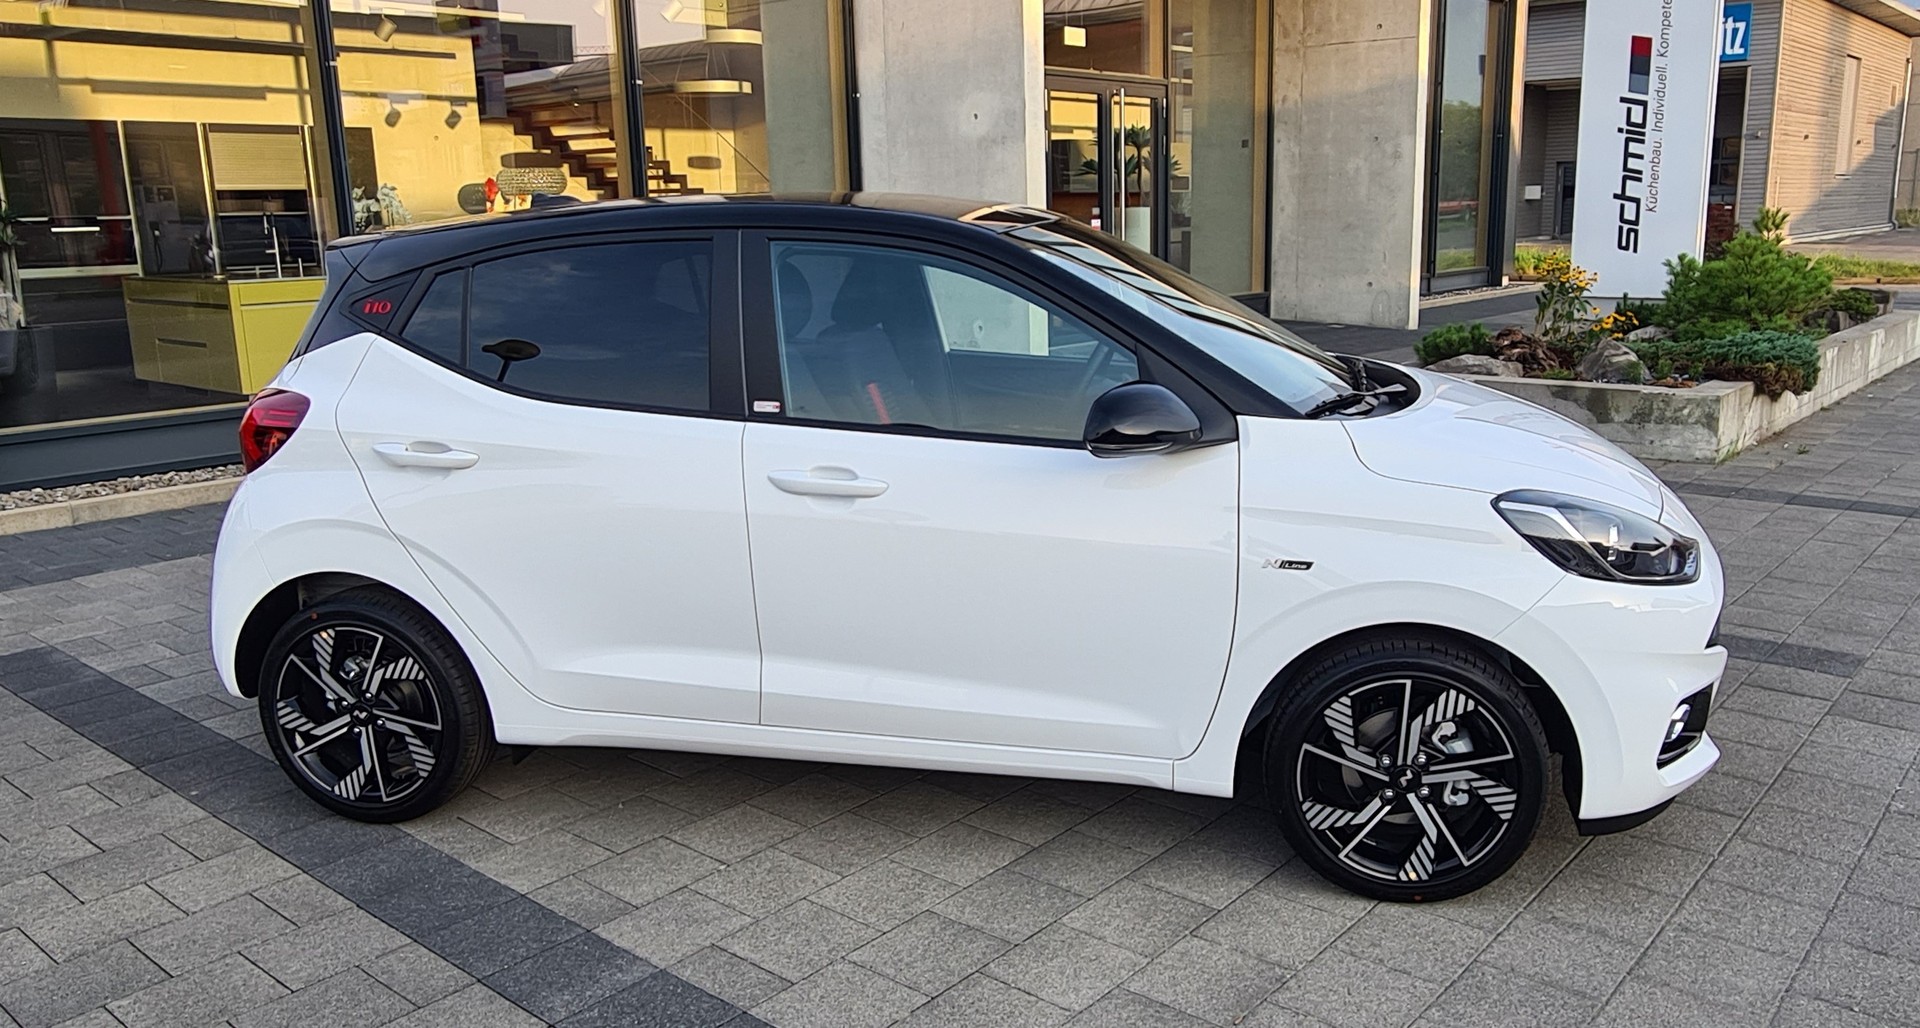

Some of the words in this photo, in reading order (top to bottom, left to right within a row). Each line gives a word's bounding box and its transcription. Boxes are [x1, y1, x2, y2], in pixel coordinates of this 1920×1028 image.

[1651, 63, 1668, 132] Individuell.
[1613, 96, 1648, 254] schmid
[1645, 138, 1663, 213] Küchenbau.
[363, 299, 392, 314] i10
